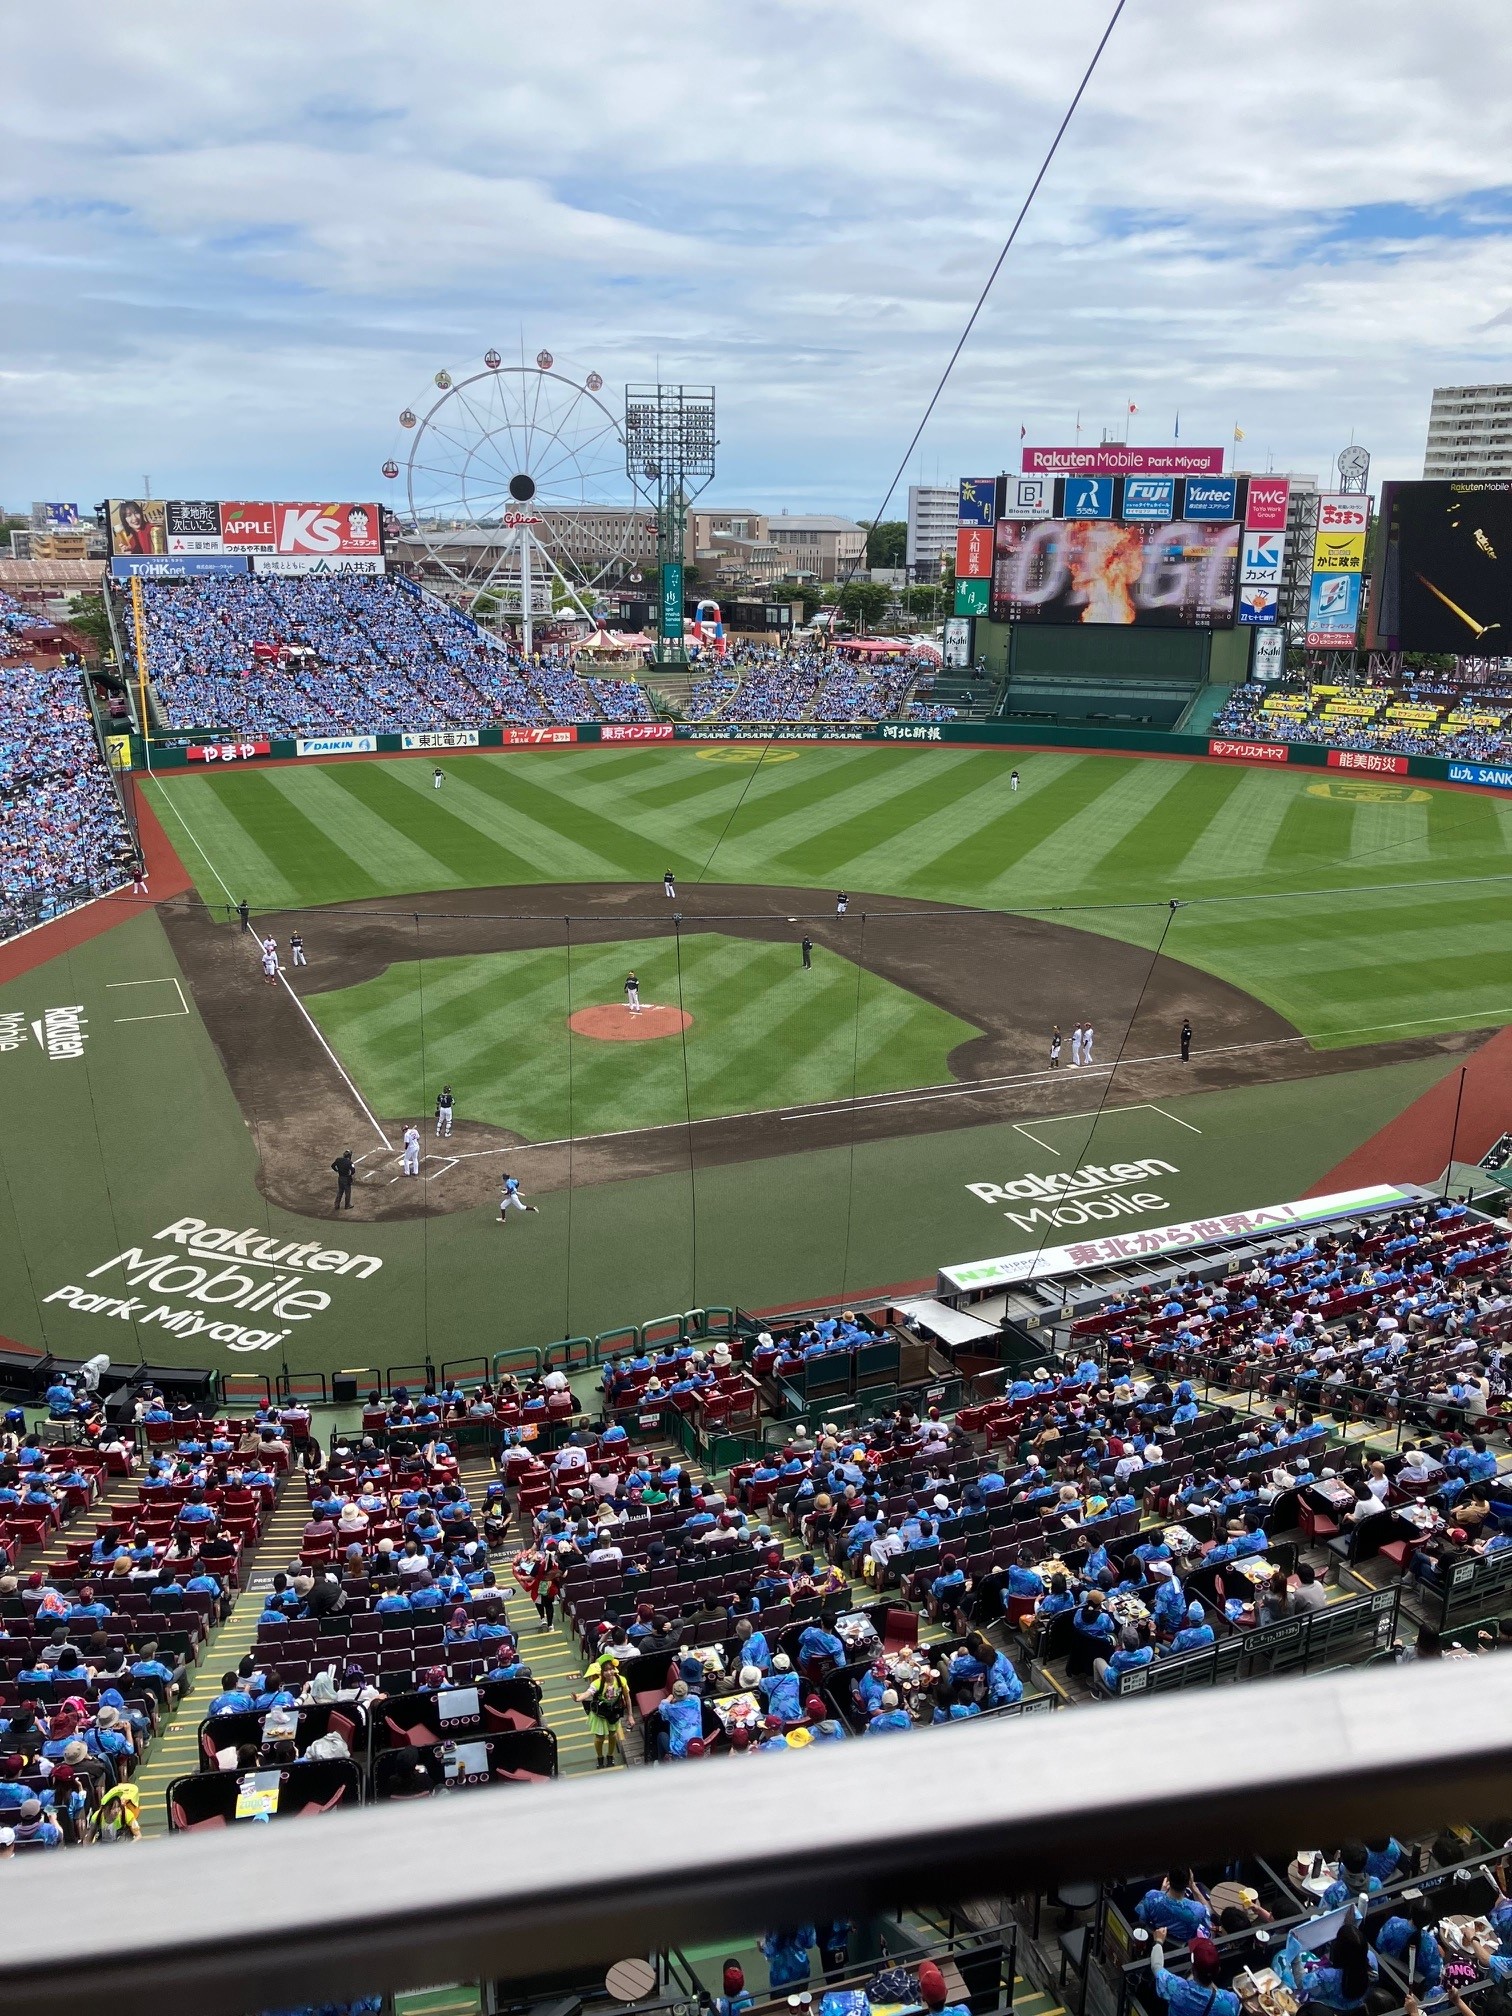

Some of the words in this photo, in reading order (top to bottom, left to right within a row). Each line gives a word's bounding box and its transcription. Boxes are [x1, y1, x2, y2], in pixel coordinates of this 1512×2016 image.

[1033, 451, 1095, 471] Rakuten
[1097, 452, 1144, 467] Mobile
[1148, 456, 1173, 467] Park
[1175, 456, 1211, 470] Miyagi
[1128, 482, 1171, 501] Fuji
[1189, 487, 1232, 502] Yurtec
[1451, 483, 1484, 493] Rakuten
[1484, 483, 1510, 491] Mobile
[1251, 490, 1286, 504] TWG
[171, 507, 215, 519] 三菱地所と
[1323, 504, 1364, 525] まるまつ
[173, 520, 217, 531] 次にいこう。
[225, 521, 273, 534] APPLE
[503, 512, 544, 529] Glico
[187, 541, 218, 550] 三菱地所
[226, 545, 274, 553] つがるや不動産
[968, 530, 981, 575] 大和証券
[263, 561, 305, 570] 地域とともに
[1317, 557, 1361, 568] かに政宗
[1245, 570, 1278, 581] カメイ
[956, 581, 989, 615] 清月記
[947, 635, 967, 645] Asahi
[1257, 646, 1281, 657] Asahi
[418, 733, 468, 747] 東北電力
[601, 726, 673, 740] 東京インテリア
[883, 725, 942, 741] 河北新報
[313, 740, 353, 750] DAIKIN
[1226, 744, 1284, 759] アイリスオーヤマ
[202, 743, 256, 762] やまや
[1339, 752, 1396, 773] 能美防災
[1450, 766, 1473, 780] 山九
[45, 1005, 89, 1060] Rakuten
[964, 1158, 1180, 1204] Rakuten
[1003, 1190, 1171, 1233] Mobile
[1064, 1206, 1304, 1267] 東北から世界へ!
[152, 1217, 383, 1279] Rakuten
[1000, 1257, 1047, 1270] NIPPON
[86, 1247, 332, 1320] Mobile
[42, 1285, 148, 1321] Park
[138, 1305, 293, 1352] Miyagi
[570, 1456, 578, 1467] 6
